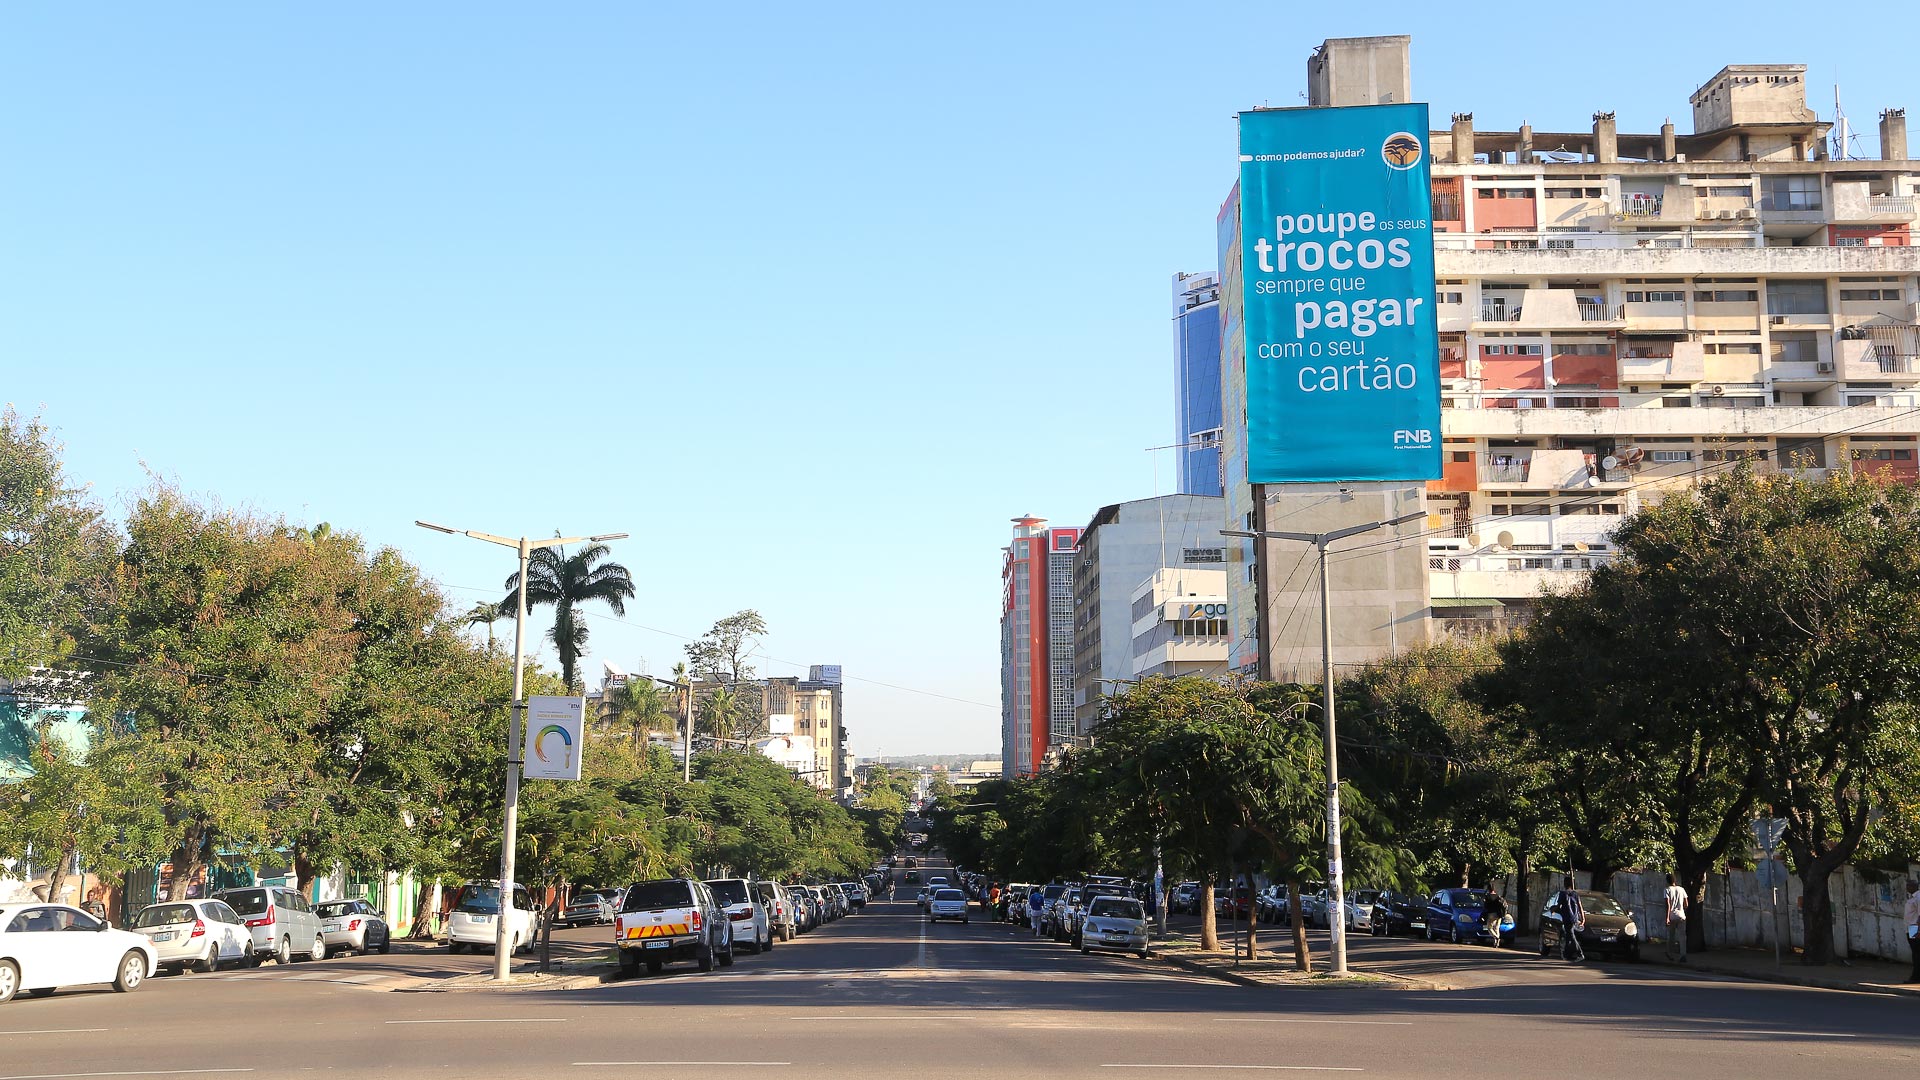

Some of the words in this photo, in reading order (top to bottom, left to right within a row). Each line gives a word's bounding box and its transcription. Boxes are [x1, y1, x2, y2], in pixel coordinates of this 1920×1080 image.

[1255, 154, 1282, 162] como
[1284, 151, 1328, 163] podemos
[1329, 148, 1366, 160] ajudar?
[1276, 211, 1376, 241] poupe
[1379, 220, 1394, 230] os
[1397, 219, 1427, 230] seus
[1254, 237, 1411, 273] trocos
[1255, 278, 1325, 297] sempre
[1329, 276, 1366, 296] que
[1295, 297, 1424, 339] pagar
[1258, 343, 1303, 359] com
[1309, 341, 1322, 357] o
[1328, 340, 1365, 357] seu
[1298, 356, 1417, 392] cartão
[1393, 429, 1433, 444] FNB
